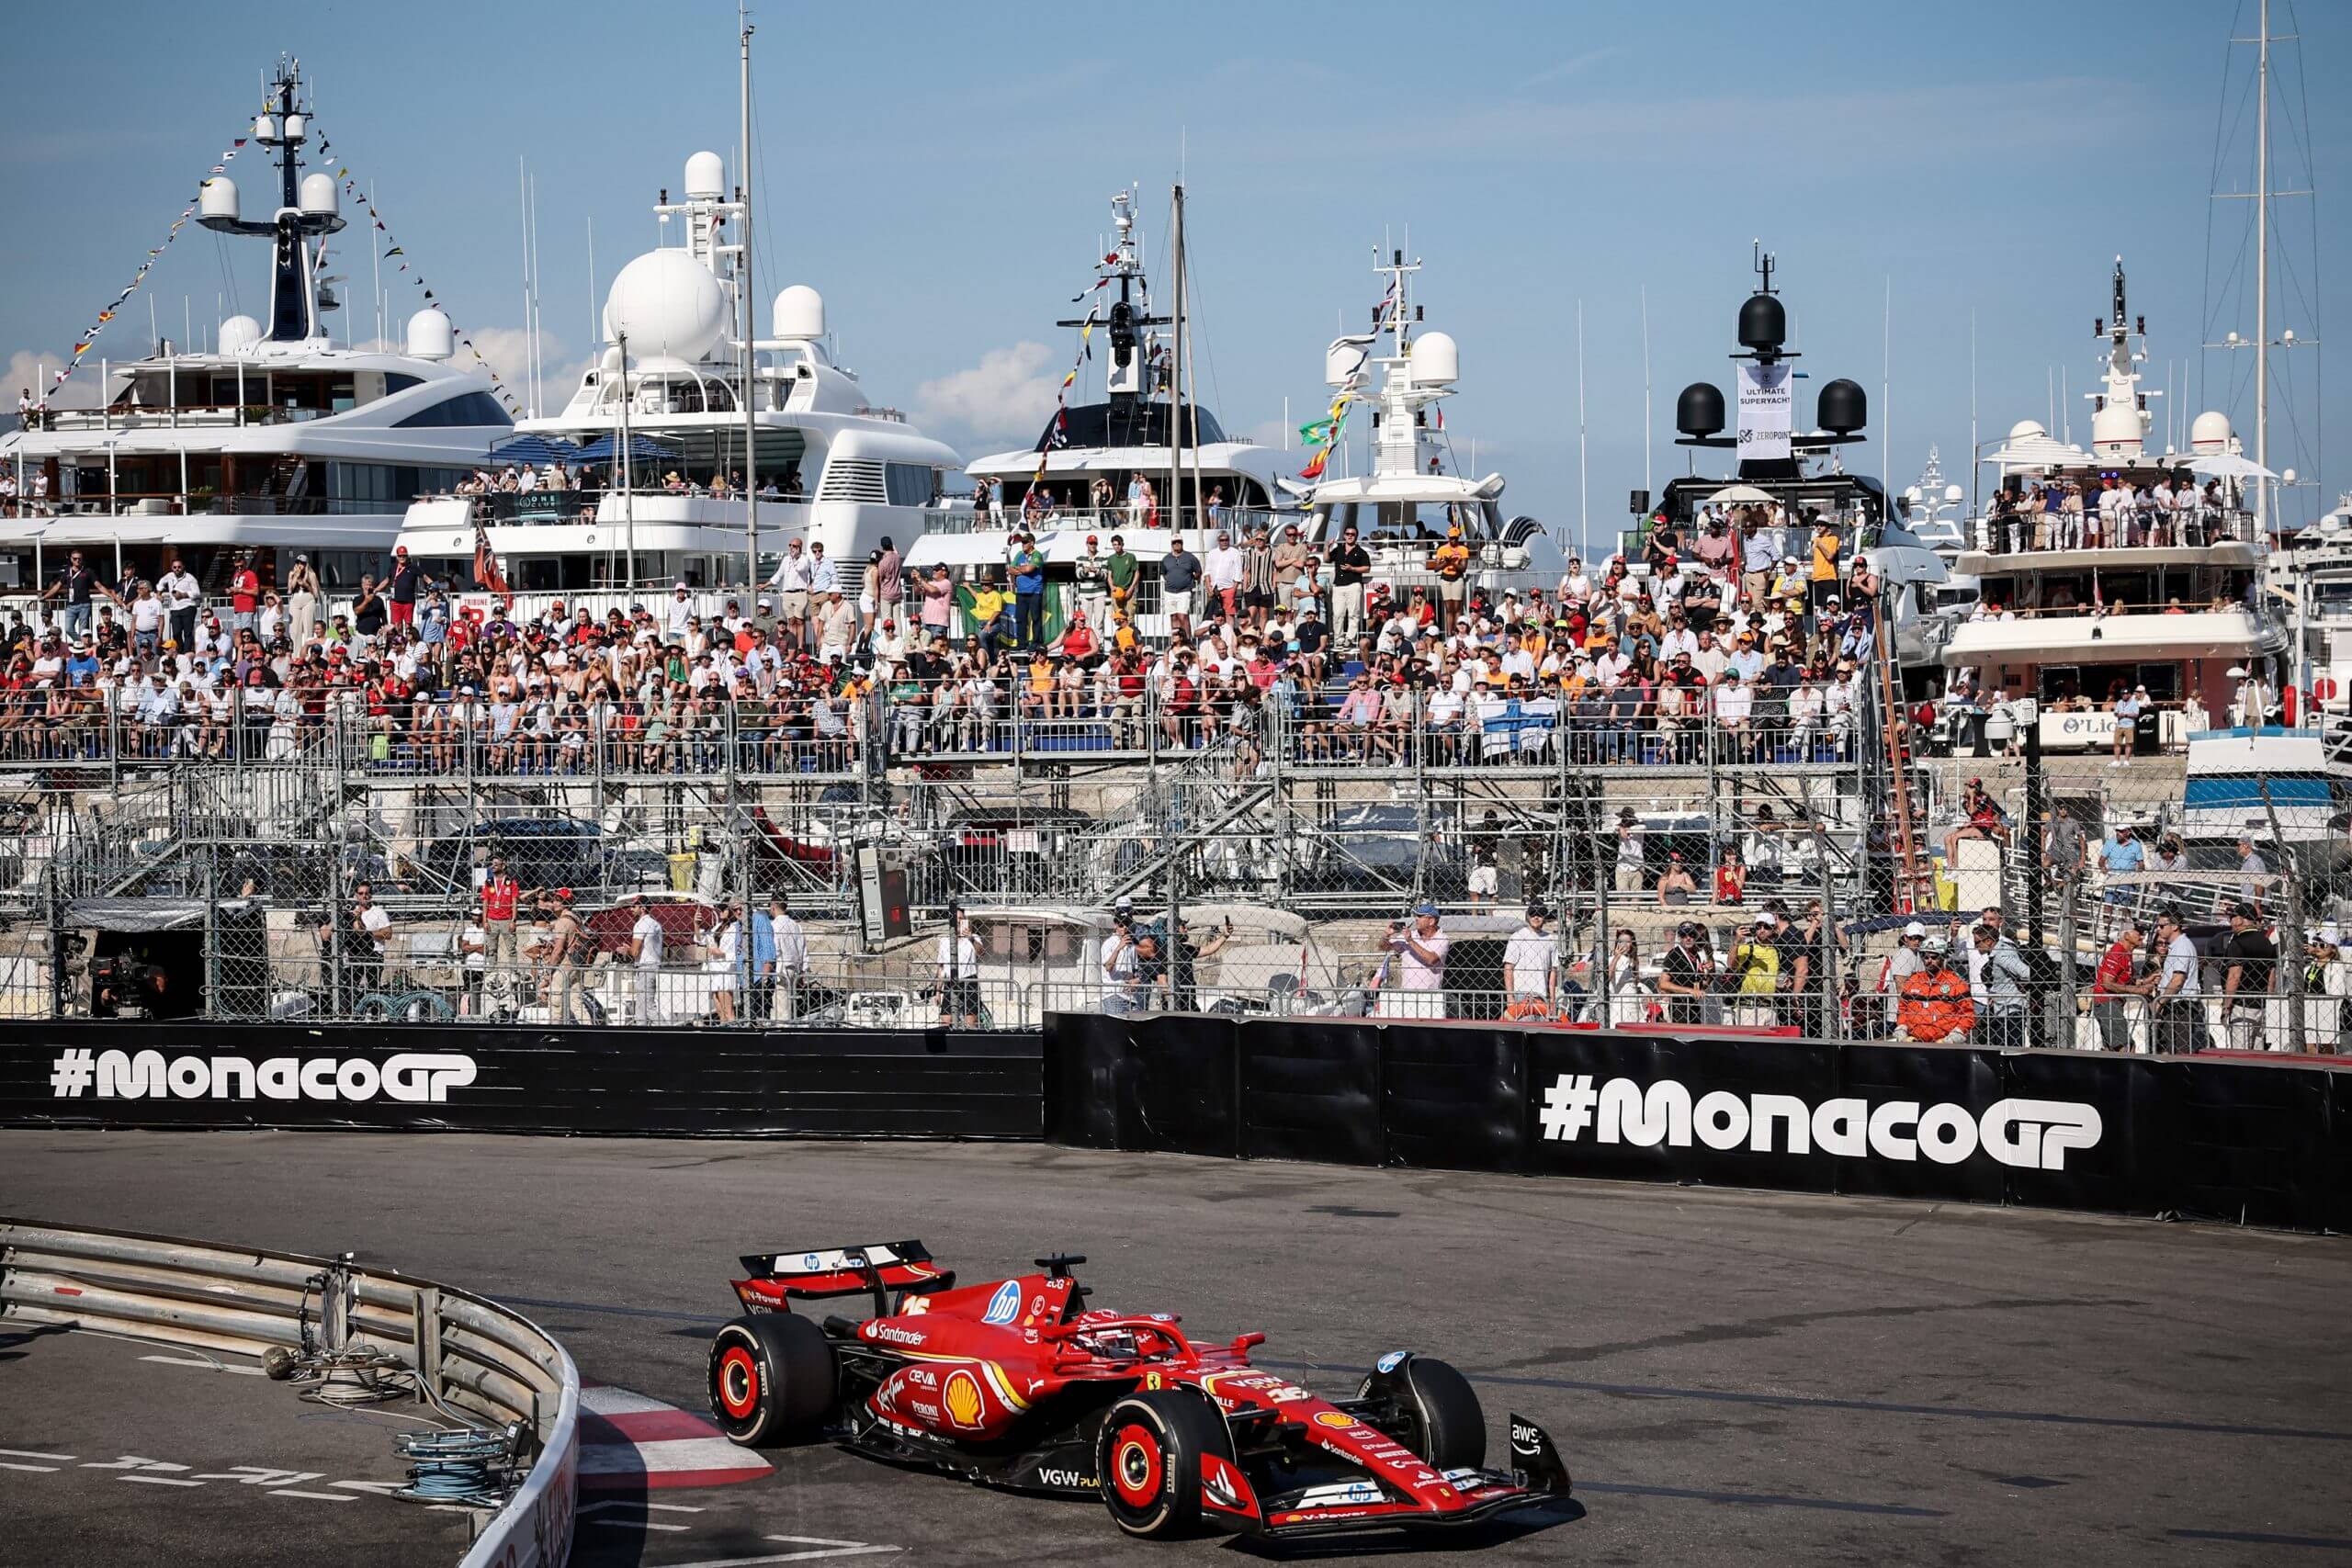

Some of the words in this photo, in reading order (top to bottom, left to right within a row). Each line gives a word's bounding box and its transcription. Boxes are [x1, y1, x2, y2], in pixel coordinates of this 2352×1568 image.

[1747, 388, 1786, 396] ULTIMATE
[1740, 397, 1791, 405] SUPERYACHT
[1757, 431, 1792, 440] ZEROPOINT
[464, 598, 489, 606] TRIBUNE
[51, 1048, 478, 1102] #MonacoGP
[1540, 1074, 2103, 1170] #MonacoGP
[804, 1254, 820, 1270] hp
[748, 1290, 782, 1305] V-Power
[985, 1282, 1019, 1323] hp
[877, 1323, 927, 1346] Santander
[1225, 1376, 1284, 1388] VGW
[911, 1400, 939, 1417] PERONI
[1512, 1425, 1539, 1443] aws
[1329, 1443, 1363, 1466] Santander
[1038, 1467, 1080, 1487] VGW
[1080, 1477, 1101, 1488] PLA
[1302, 1511, 1367, 1520] V-Power
